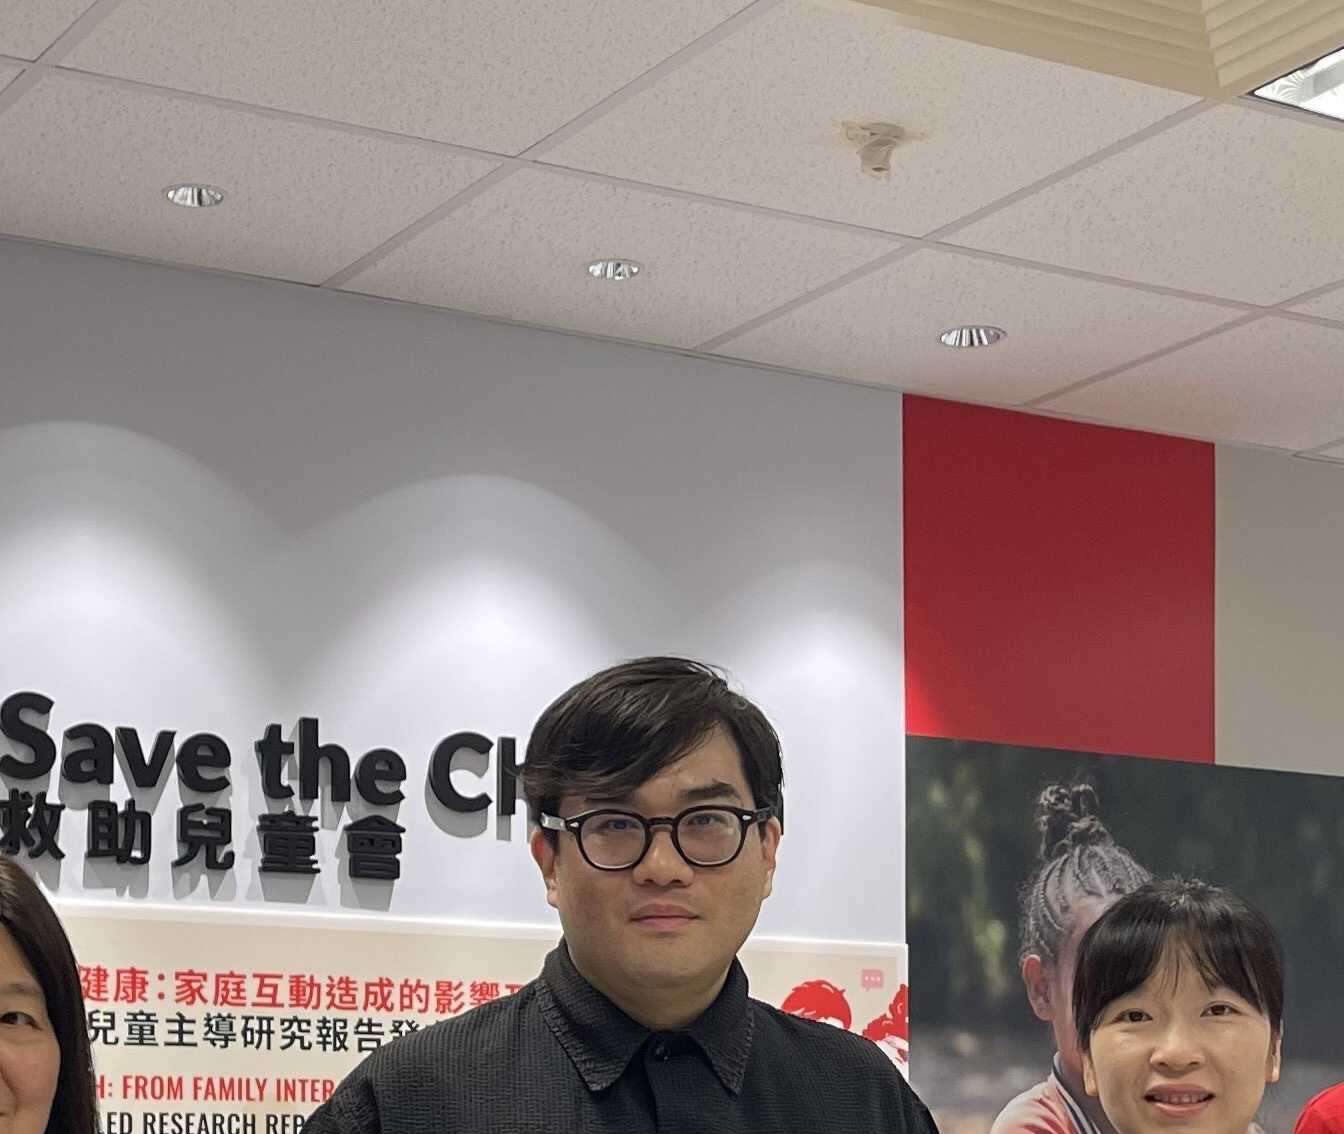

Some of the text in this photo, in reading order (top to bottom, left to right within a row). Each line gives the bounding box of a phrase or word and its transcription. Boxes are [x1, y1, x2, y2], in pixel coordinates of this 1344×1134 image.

[256, 717, 407, 805] the
[122, 1075, 184, 1101] FROM
[193, 1076, 267, 1103] FAMILY
